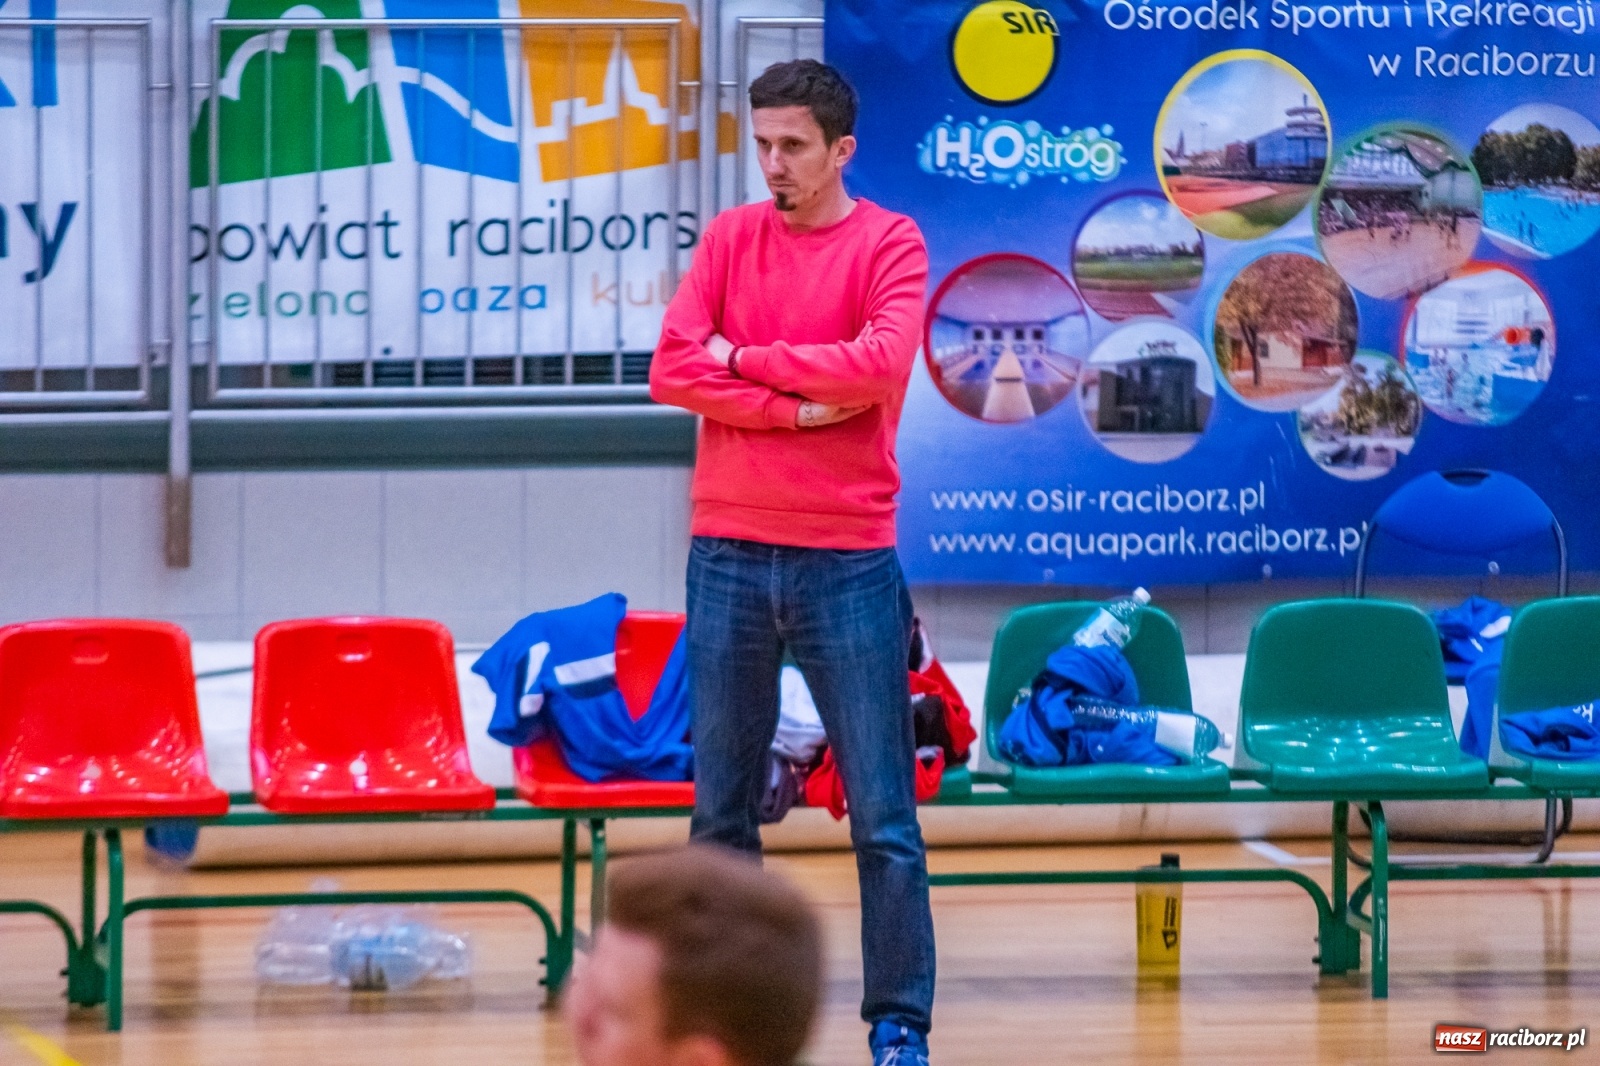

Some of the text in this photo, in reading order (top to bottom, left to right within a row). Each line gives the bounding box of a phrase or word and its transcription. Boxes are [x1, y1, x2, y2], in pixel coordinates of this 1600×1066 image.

[1104, 0, 1596, 36] Ośrodek Sportu i Rekreacji
[1368, 44, 1596, 77] w Raciborzu
[930, 481, 1266, 513] www.osir-raciborz.pl
